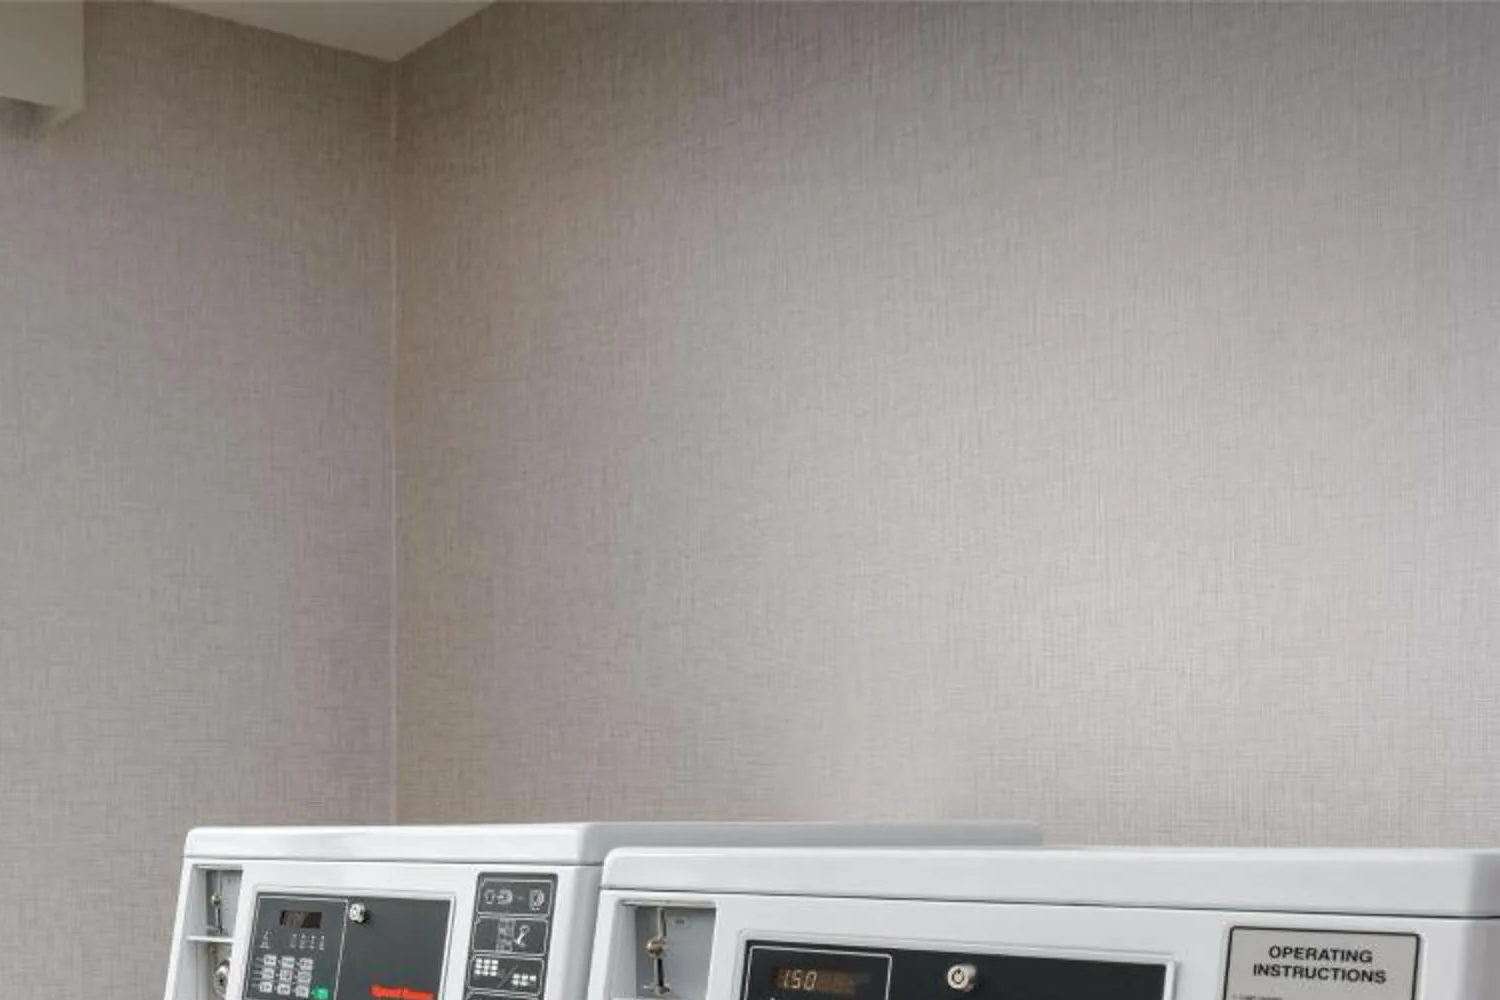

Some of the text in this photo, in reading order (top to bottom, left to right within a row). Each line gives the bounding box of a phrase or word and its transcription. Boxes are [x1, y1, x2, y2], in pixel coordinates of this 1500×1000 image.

[1267, 945, 1374, 964] OPERATING
[783, 969, 818, 991] 150
[1252, 963, 1388, 984] INSTRUCTIONS
